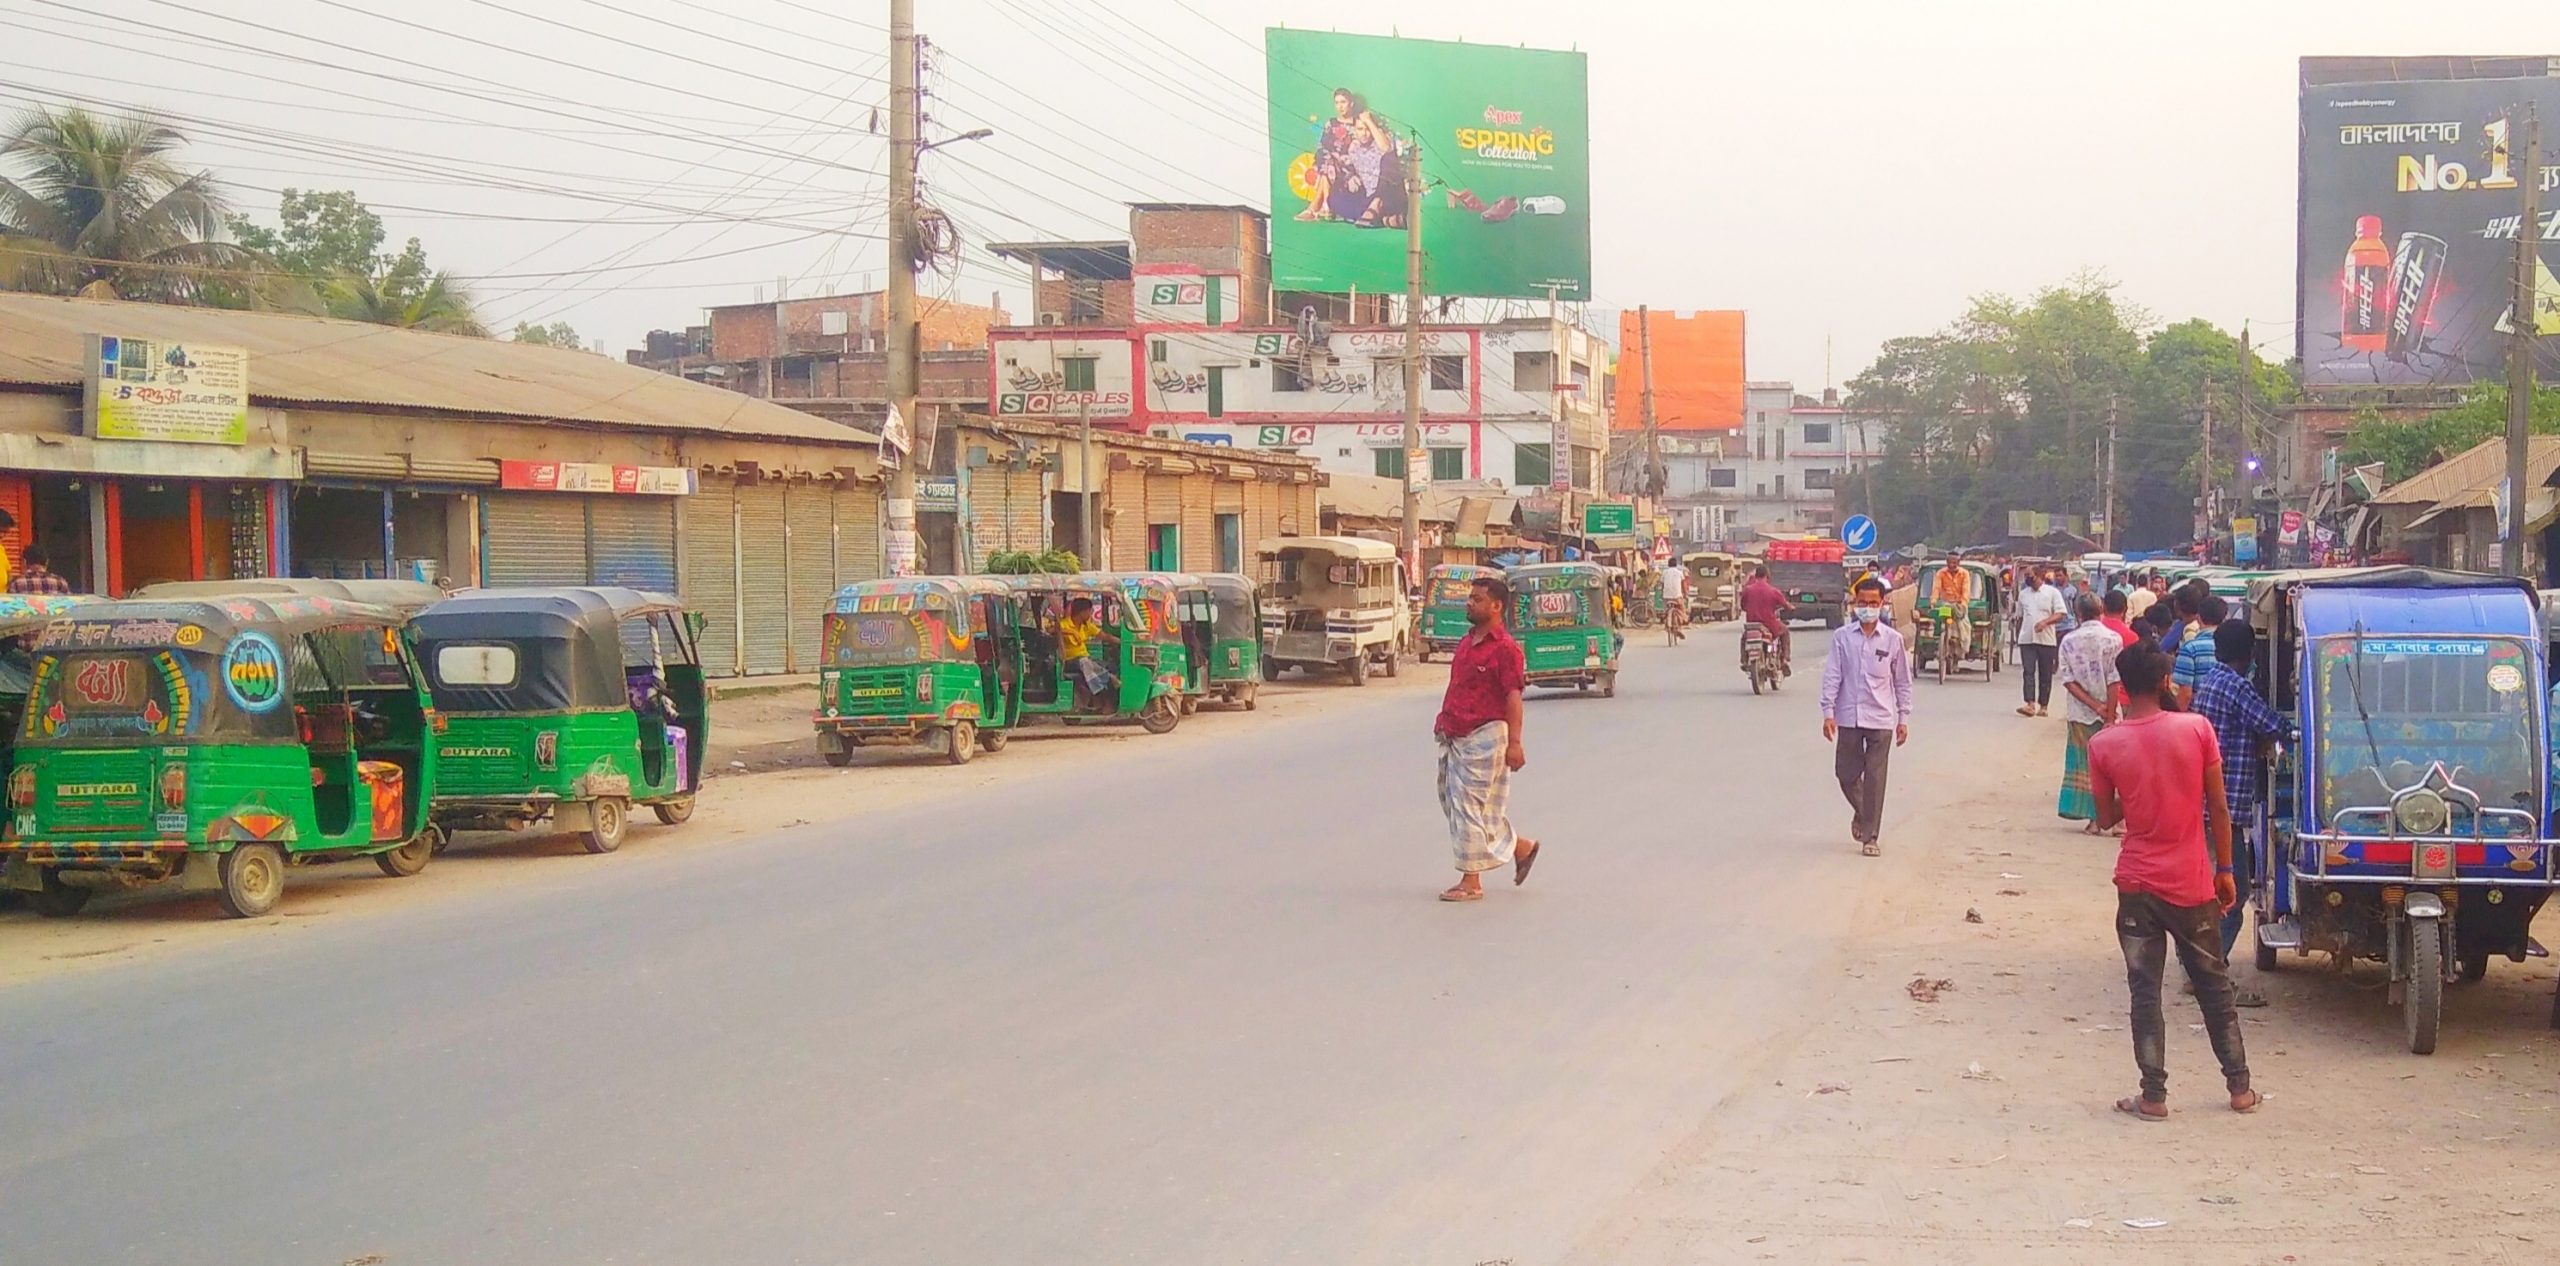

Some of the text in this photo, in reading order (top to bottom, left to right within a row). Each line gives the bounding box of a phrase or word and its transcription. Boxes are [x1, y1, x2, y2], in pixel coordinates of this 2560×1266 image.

[1484, 104, 1522, 127] Apex
[1461, 128, 1553, 155] SPRING
[2339, 121, 2462, 145] বাংলাদেশের
[1477, 143, 1537, 161] Collection
[1155, 285, 1203, 304] SQ
[2393, 258, 2425, 336] SPEED
[135, 385, 182, 404] বগুড়া
[999, 392, 1130, 414] SQ CABLES
[1259, 424, 1451, 445] SQ LIGTS
[859, 689, 903, 698] UTTARA
[452, 748, 510, 757] UTTARA
[69, 784, 136, 796] UTTARA
[16, 814, 36, 836] CNG
